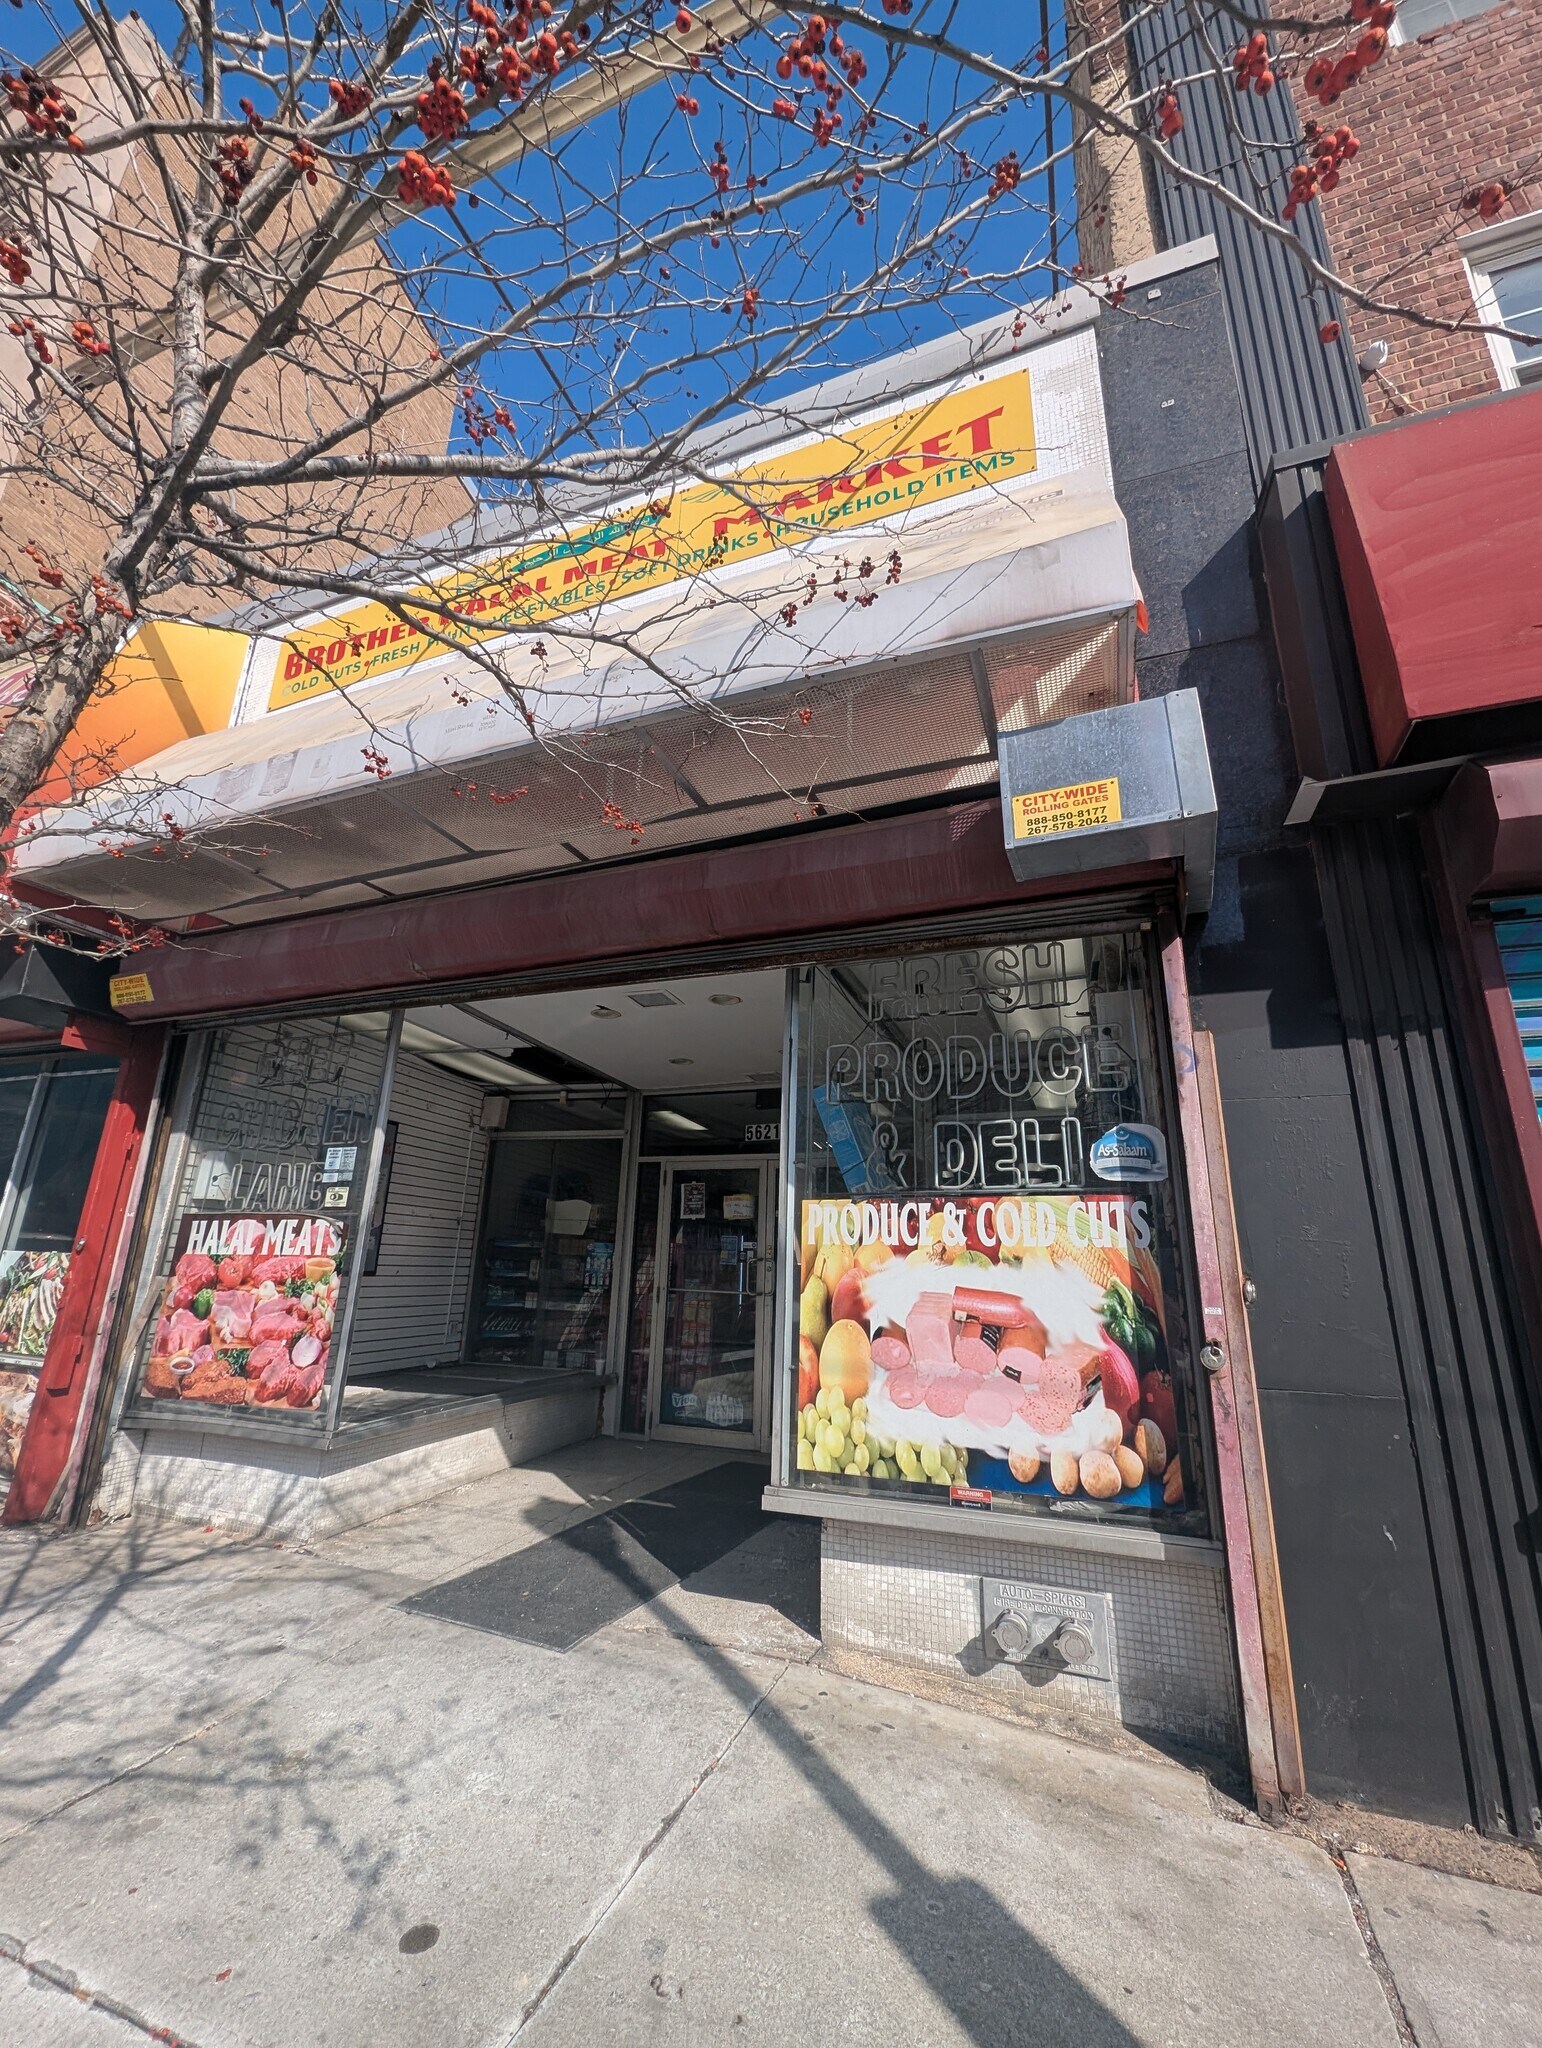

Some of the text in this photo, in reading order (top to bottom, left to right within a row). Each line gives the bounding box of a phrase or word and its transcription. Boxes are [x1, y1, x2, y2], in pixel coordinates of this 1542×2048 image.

[563, 536, 671, 585] MEAT
[713, 406, 1004, 537] MARKET
[325, 661, 361, 683] CUTS
[372, 641, 420, 667] FRESH
[427, 624, 471, 646] FUIT
[492, 580, 606, 625] VEGETABLES
[676, 531, 758, 568] DRINKS
[776, 479, 923, 537] HOUSEHOLD
[936, 452, 1016, 487] ITEMS
[1022, 783, 1108, 807] CITY-WIDE
[1022, 794, 1109, 816] ROLLING GATES
[1026, 806, 1107, 826] 888-850-8177
[1027, 815, 1108, 835] 267-578-2042
[869, 941, 1068, 1022] FRESH
[827, 1023, 1128, 1105] PRODUCE
[746, 1124, 779, 1140] 5621
[866, 1117, 1086, 1191] & DELI
[1097, 1143, 1147, 1156] As-Salaam
[807, 1201, 1151, 1248] PRODUCE & COLD CUTS
[185, 1219, 344, 1256] HALAL MEATS
[956, 1490, 984, 1498] WARNING
[994, 1598, 1014, 1608] FIRE
[1041, 1604, 1094, 1620] CONNECTION
